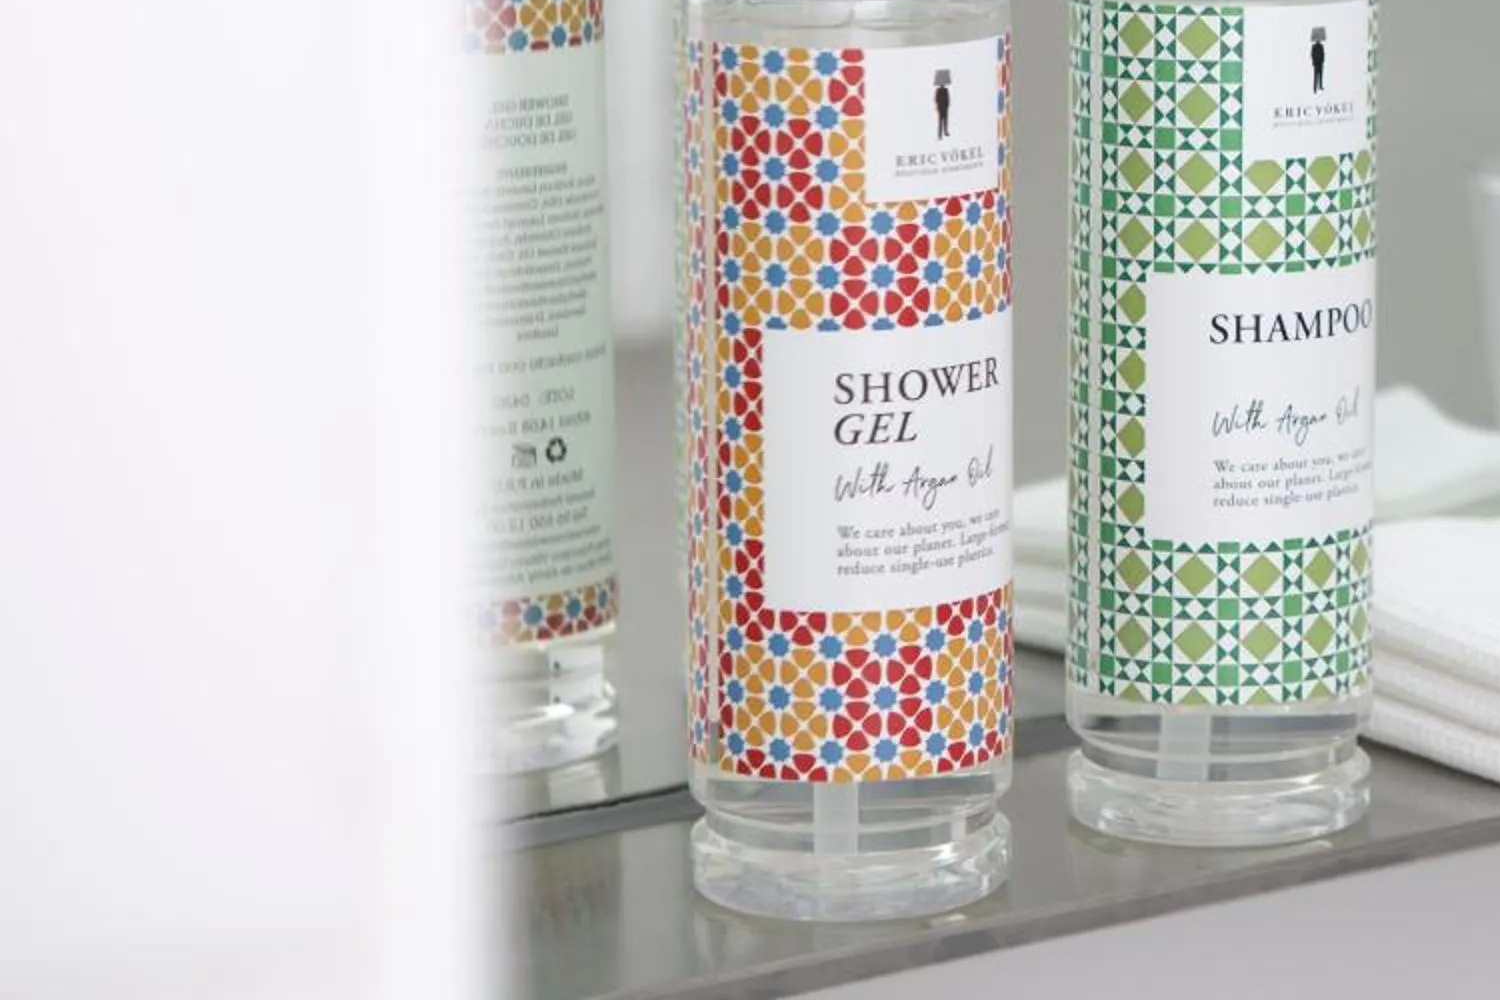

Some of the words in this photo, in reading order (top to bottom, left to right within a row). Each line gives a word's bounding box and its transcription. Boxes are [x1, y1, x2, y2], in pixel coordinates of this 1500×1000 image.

[895, 153, 937, 167] ERIC
[1209, 298, 1372, 344] SHAMPOO
[834, 356, 999, 405] SHOWER
[1212, 398, 1267, 437] With
[1277, 404, 1327, 446] Argan
[1336, 385, 1360, 425] Oil
[834, 411, 918, 445] GEL
[1213, 459, 1235, 473] We
[1241, 462, 1268, 473] care
[1273, 458, 1307, 471] about
[834, 461, 896, 503] With
[902, 465, 957, 511] Argan
[967, 443, 993, 488] Oil
[1213, 476, 1252, 489] about
[1257, 479, 1281, 489] our
[1213, 493, 1259, 507] reduce
[837, 525, 860, 539] We
[864, 526, 894, 539] care
[900, 522, 937, 537] about
[837, 542, 878, 558] about
[884, 544, 908, 556] our
[913, 538, 956, 556] planet.
[837, 561, 885, 577] reduce
[890, 554, 955, 575] single-use
